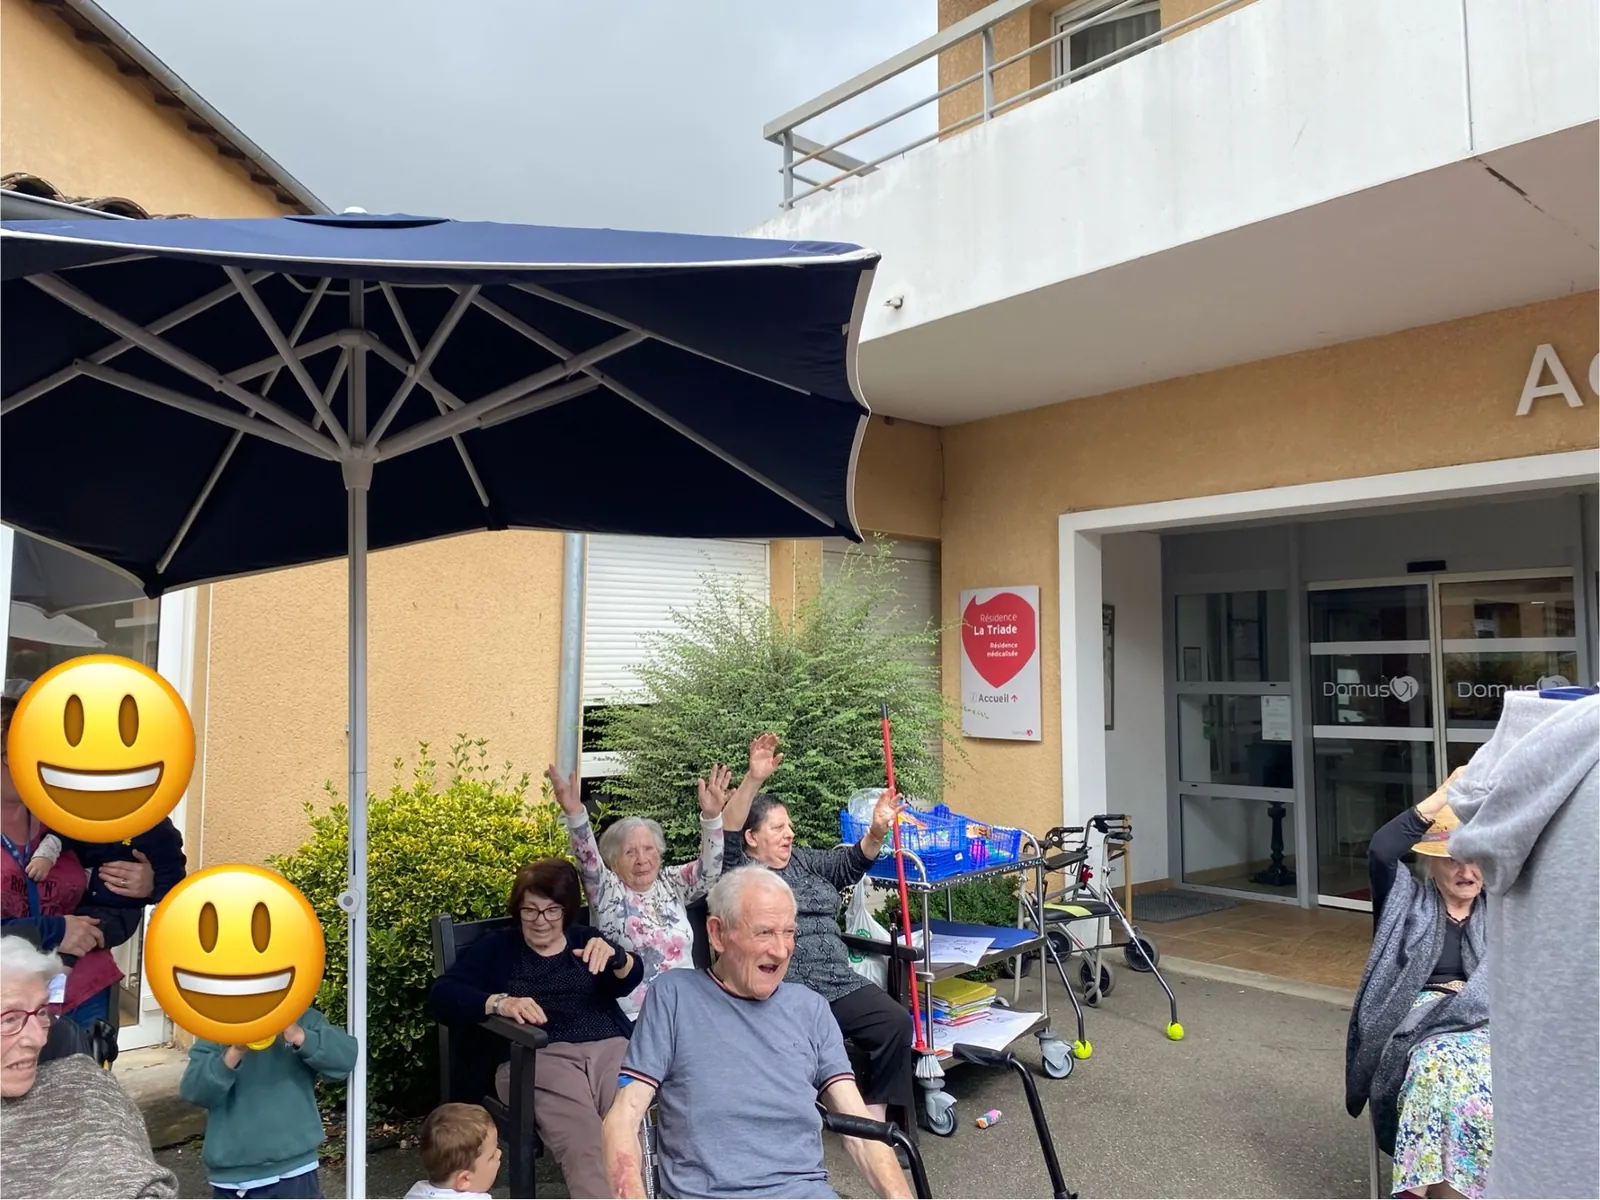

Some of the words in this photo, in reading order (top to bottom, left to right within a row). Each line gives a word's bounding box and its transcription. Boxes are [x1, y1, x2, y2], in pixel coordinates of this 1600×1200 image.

[1515, 343, 1599, 416] A
[980, 613, 1018, 623] Résidence
[974, 626, 984, 636] La
[987, 624, 1018, 635] Triade
[989, 641, 1018, 649] Résidence
[978, 693, 1009, 703] Accueil
